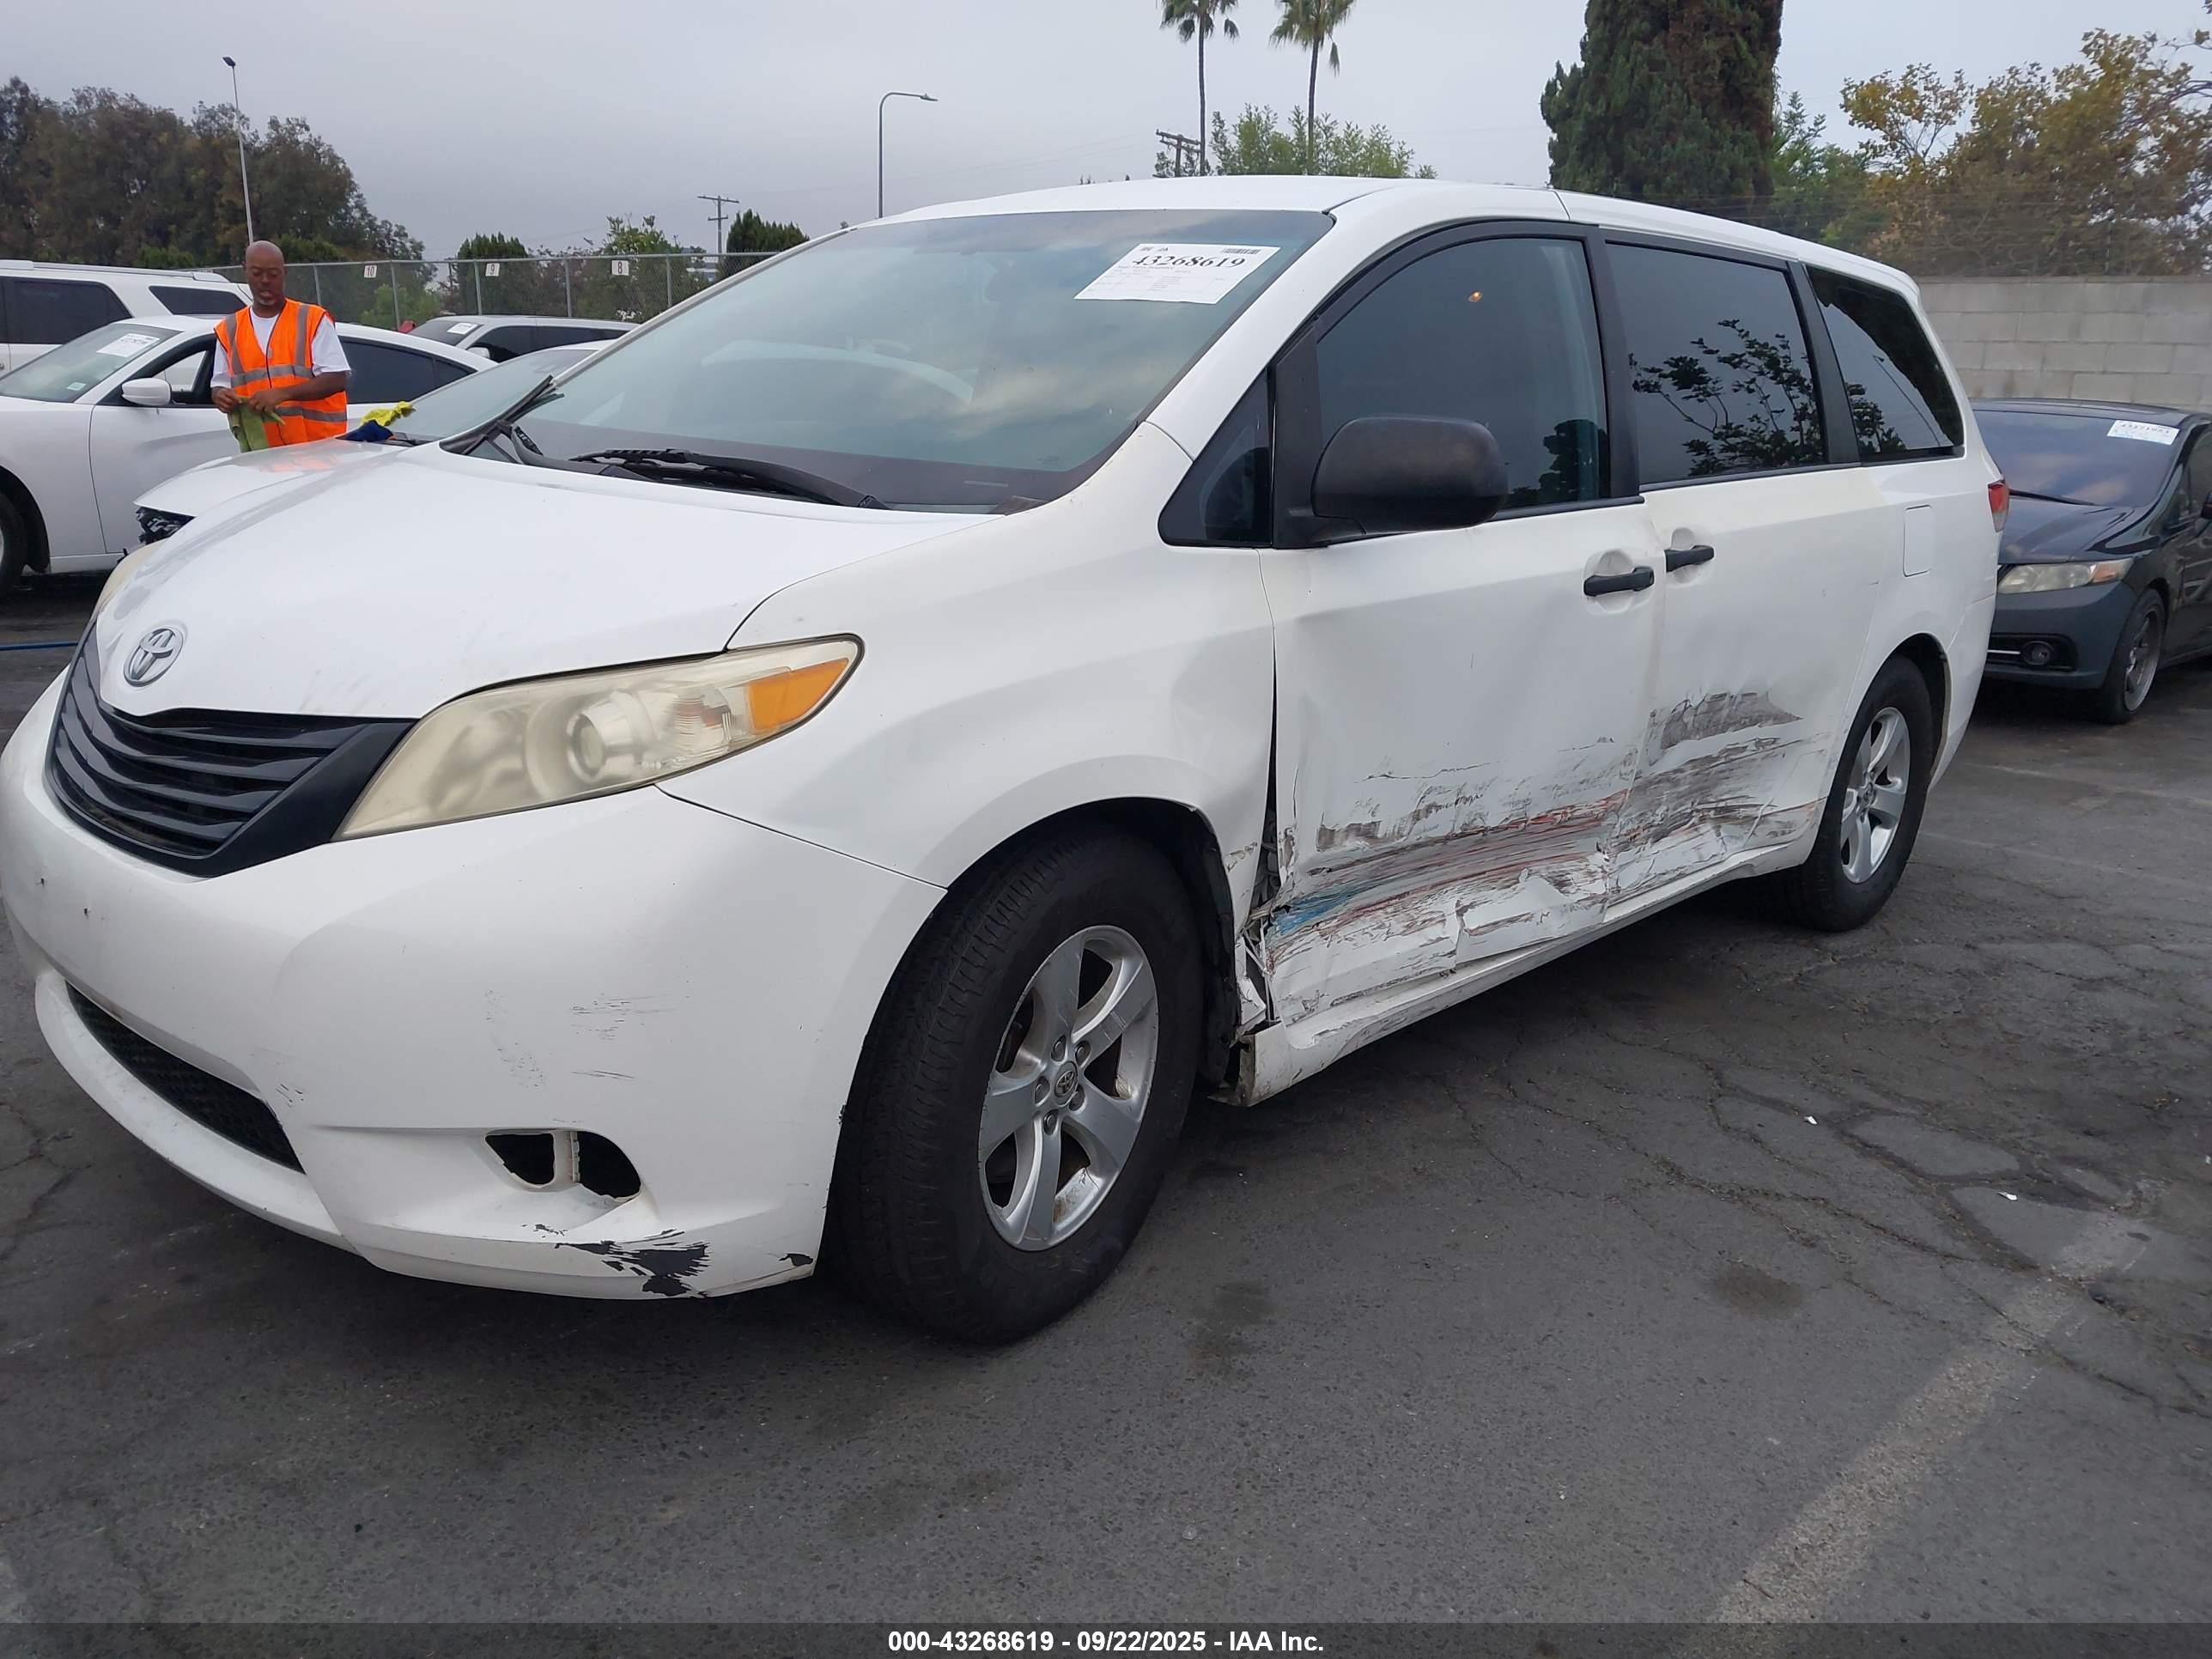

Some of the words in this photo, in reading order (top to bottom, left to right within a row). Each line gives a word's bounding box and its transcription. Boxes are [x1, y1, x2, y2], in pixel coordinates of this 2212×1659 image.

[617, 261, 623, 275] 8
[1133, 255, 1246, 268] 43268619
[366, 266, 375, 276] 10
[489, 263, 495, 276] 9
